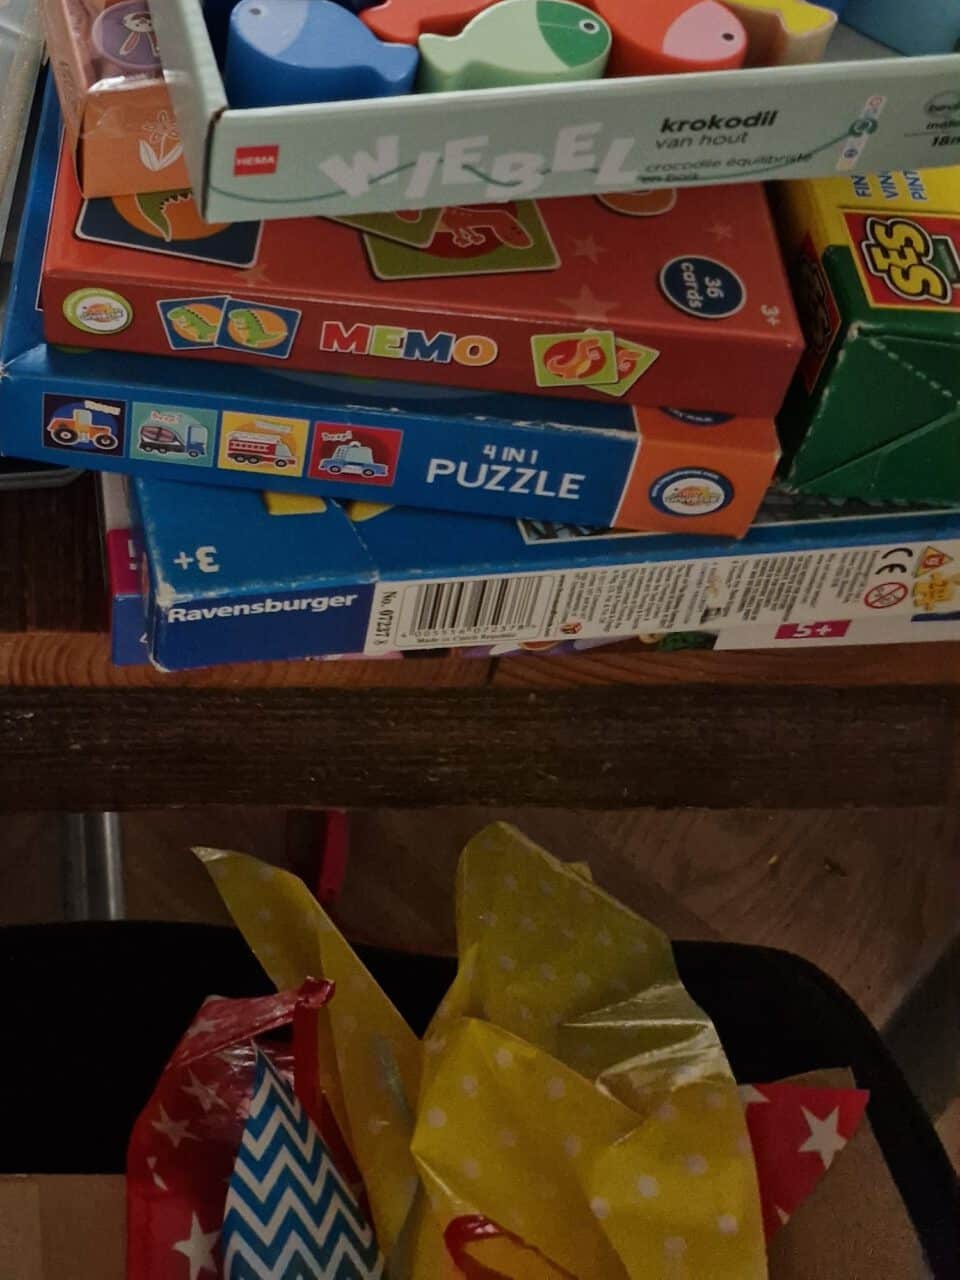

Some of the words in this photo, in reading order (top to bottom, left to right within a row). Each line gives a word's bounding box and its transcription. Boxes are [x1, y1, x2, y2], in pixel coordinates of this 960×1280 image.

[659, 110, 780, 134] krokodil
[655, 138, 693, 151] van
[698, 133, 749, 147] hout
[236, 155, 274, 166] HEMA
[320, 122, 638, 199] WIEBEL
[865, 218, 950, 303] SES
[681, 261, 702, 308] cards
[705, 275, 721, 298] 36
[759, 303, 781, 328] 3+
[321, 321, 499, 367] MEMO
[483, 444, 497, 460] 4
[501, 447, 526, 463] IN
[426, 458, 586, 499] PUZZLE
[173, 546, 220, 573] 3+
[167, 594, 358, 623] Ravensburger
[793, 622, 833, 638] 5+
